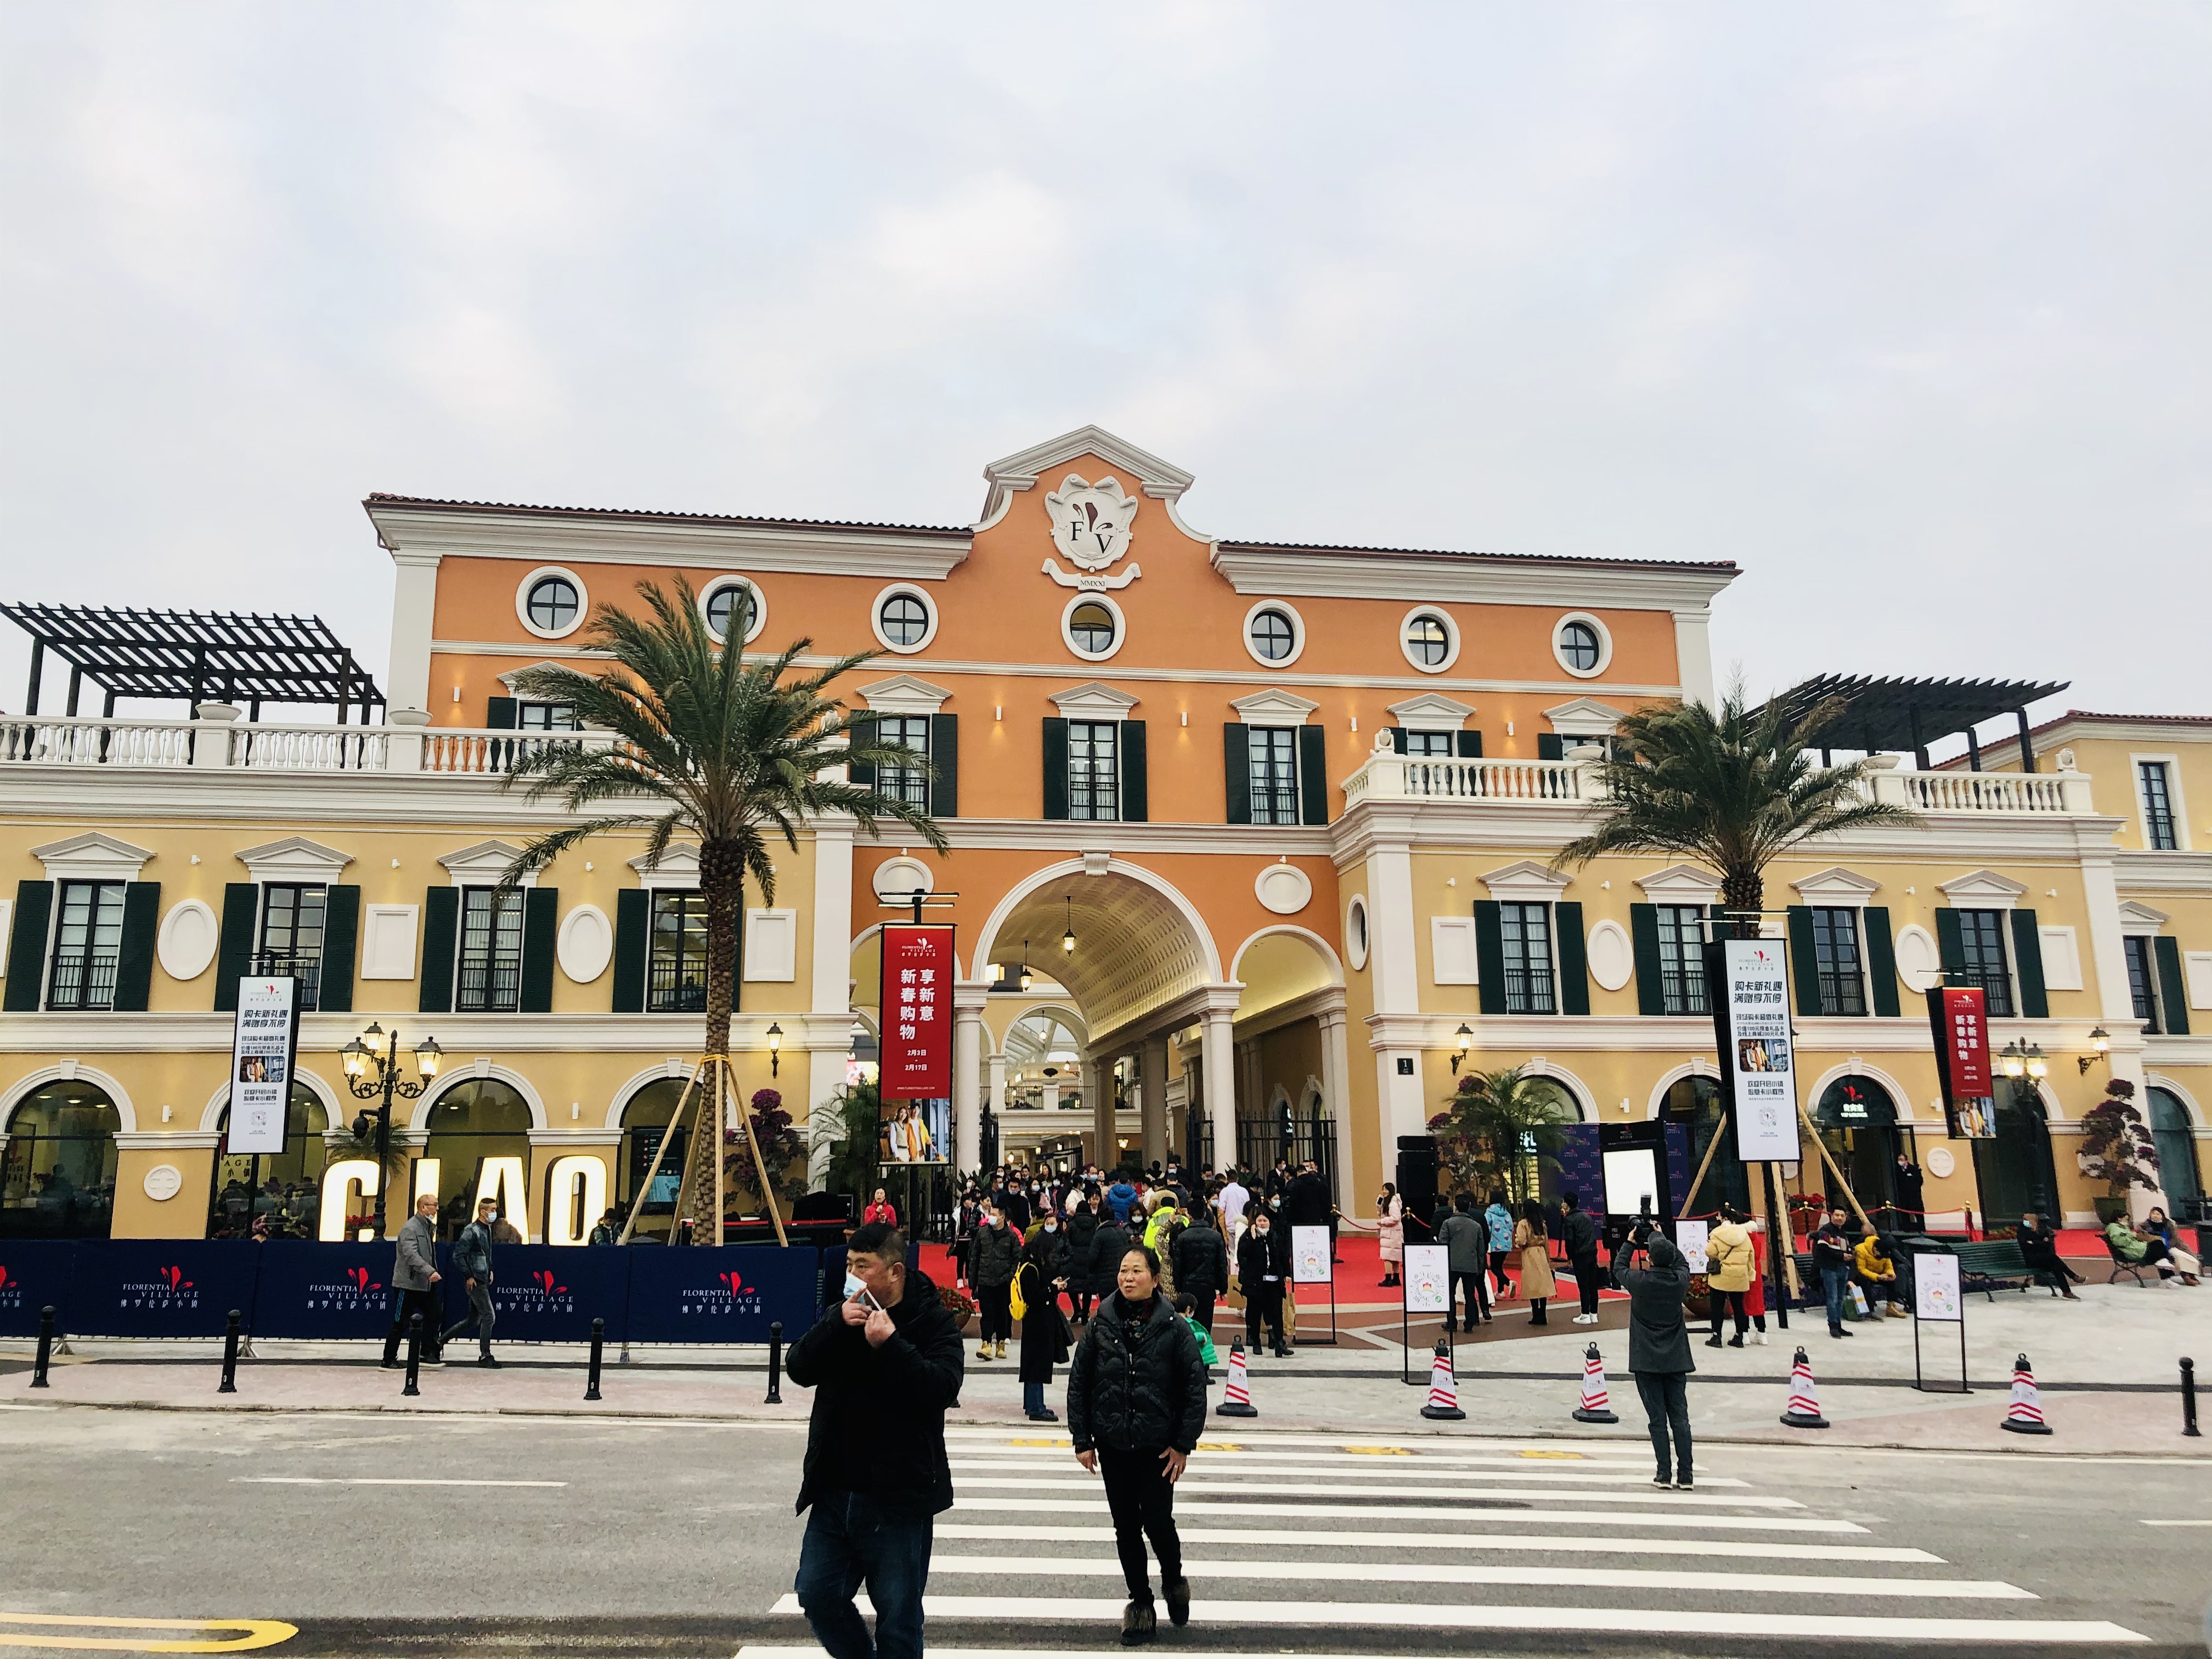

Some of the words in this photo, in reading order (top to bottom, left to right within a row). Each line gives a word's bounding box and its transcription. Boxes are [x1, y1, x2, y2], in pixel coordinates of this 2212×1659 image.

[1070, 521, 1084, 541] F
[1094, 533, 1113, 554] V
[919, 968, 935, 1021] 享新意
[1734, 993, 1782, 1003] 满赠享不停
[1735, 981, 1782, 991] 购卡新礼遇
[900, 968, 917, 1040] 新春购物
[1403, 1059, 1407, 1068] 1
[318, 1156, 608, 1246] CIAO
